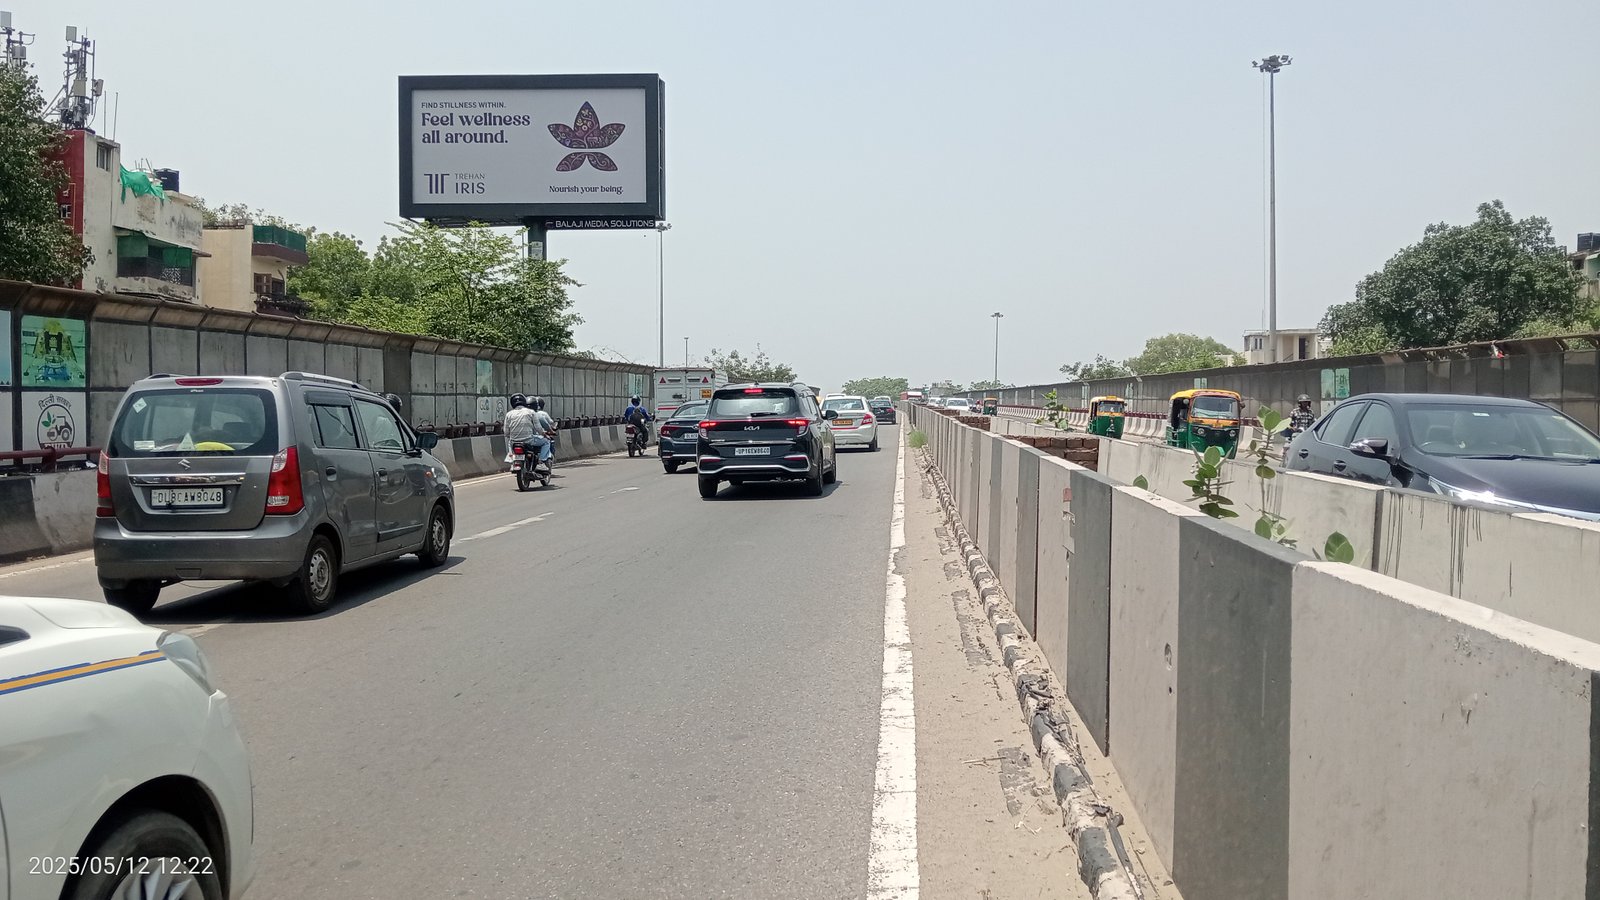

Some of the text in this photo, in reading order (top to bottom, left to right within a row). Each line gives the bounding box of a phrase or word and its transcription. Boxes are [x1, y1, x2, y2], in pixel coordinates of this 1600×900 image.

[421, 113, 531, 126] Feel wellness
[421, 130, 509, 143] all around.
[455, 182, 486, 194] IRIS
[549, 185, 624, 195] Nourish your being.
[555, 219, 655, 228] BALAJI MEDIA SOLUTIONS
